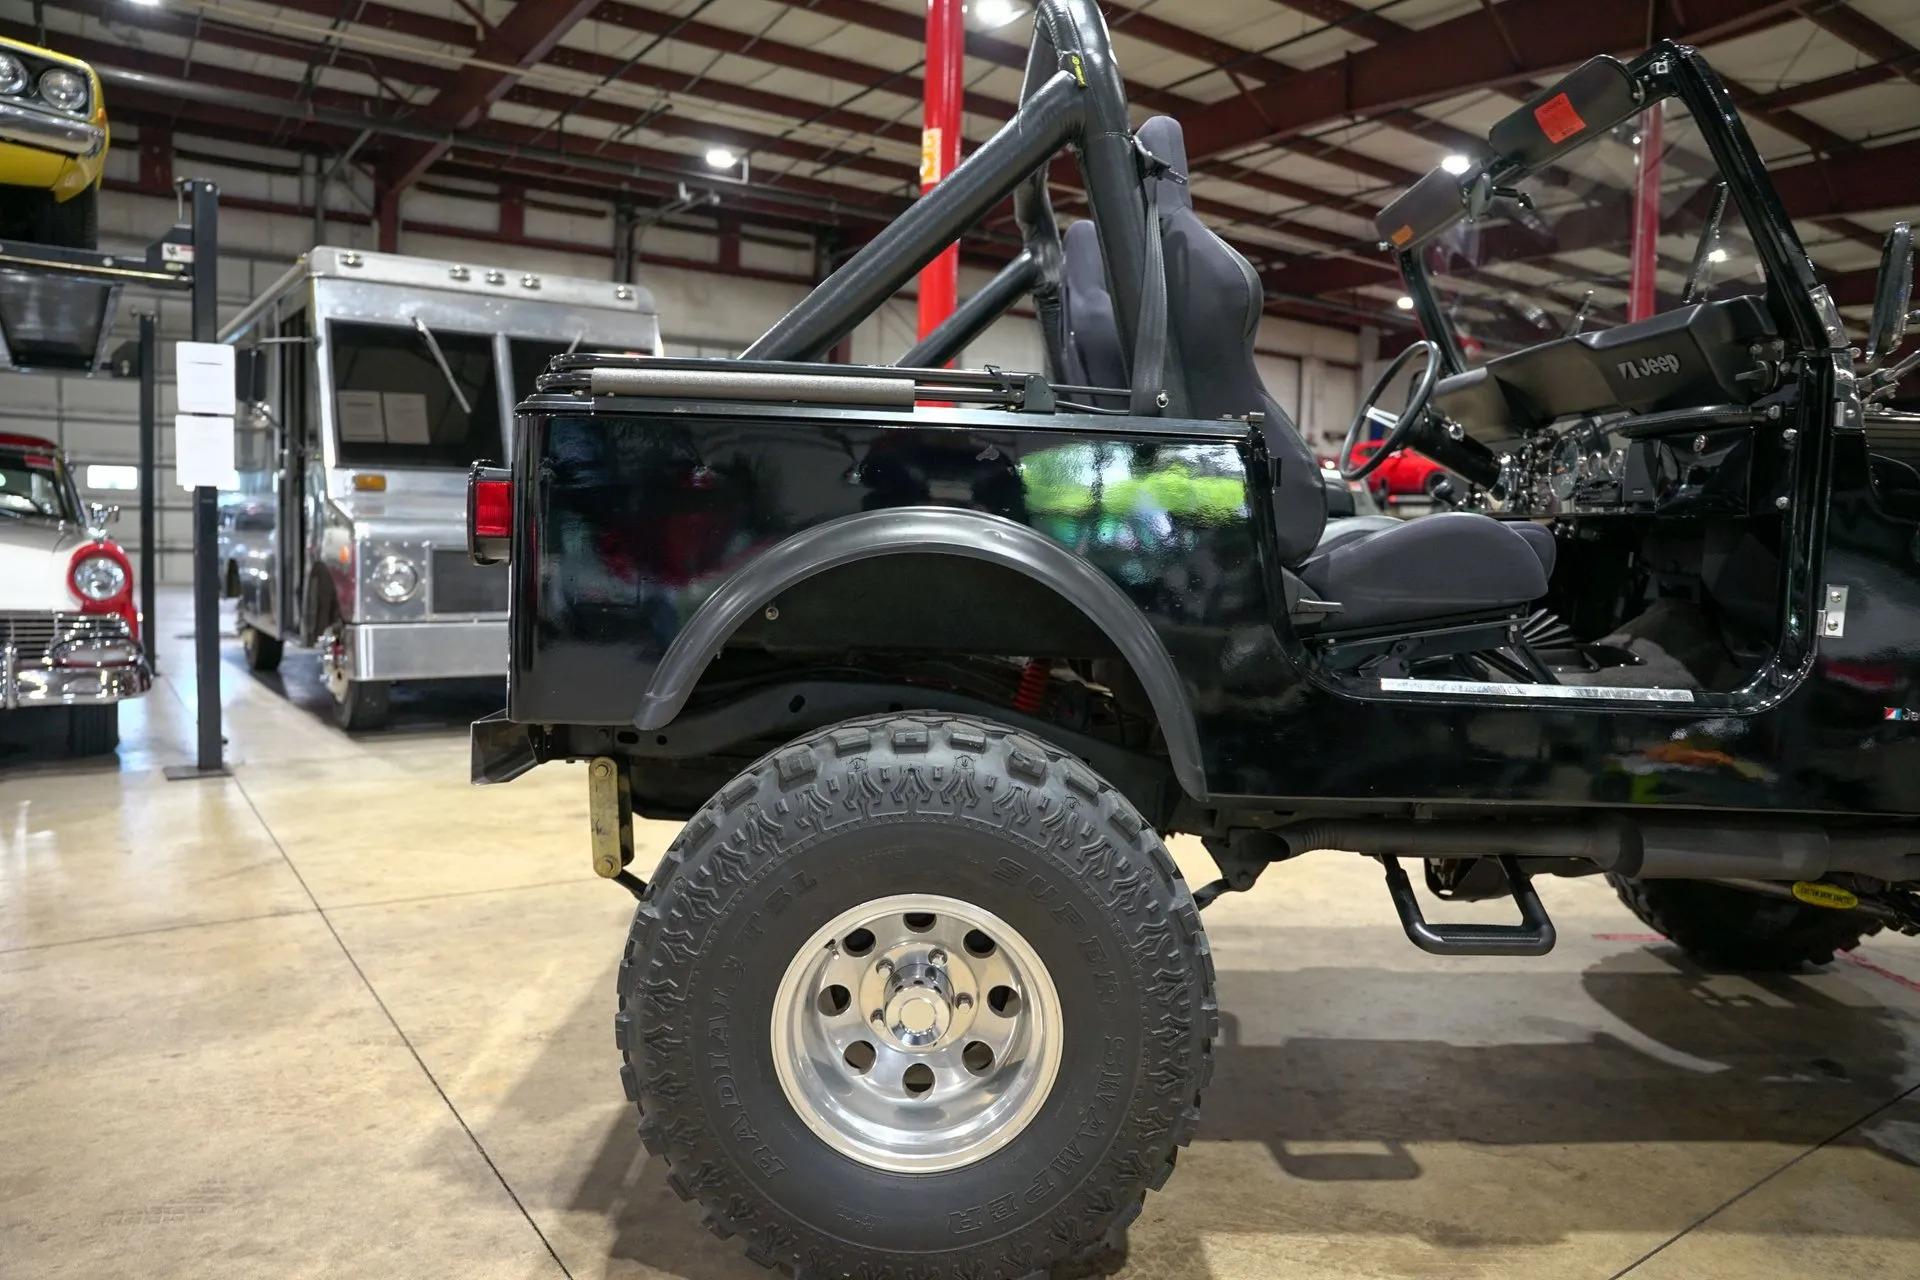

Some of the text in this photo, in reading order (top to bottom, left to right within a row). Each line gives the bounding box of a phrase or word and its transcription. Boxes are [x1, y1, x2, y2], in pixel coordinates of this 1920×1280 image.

[1639, 354, 1680, 376] Jeep
[948, 856, 1125, 1235] SUPER SWAMPER
